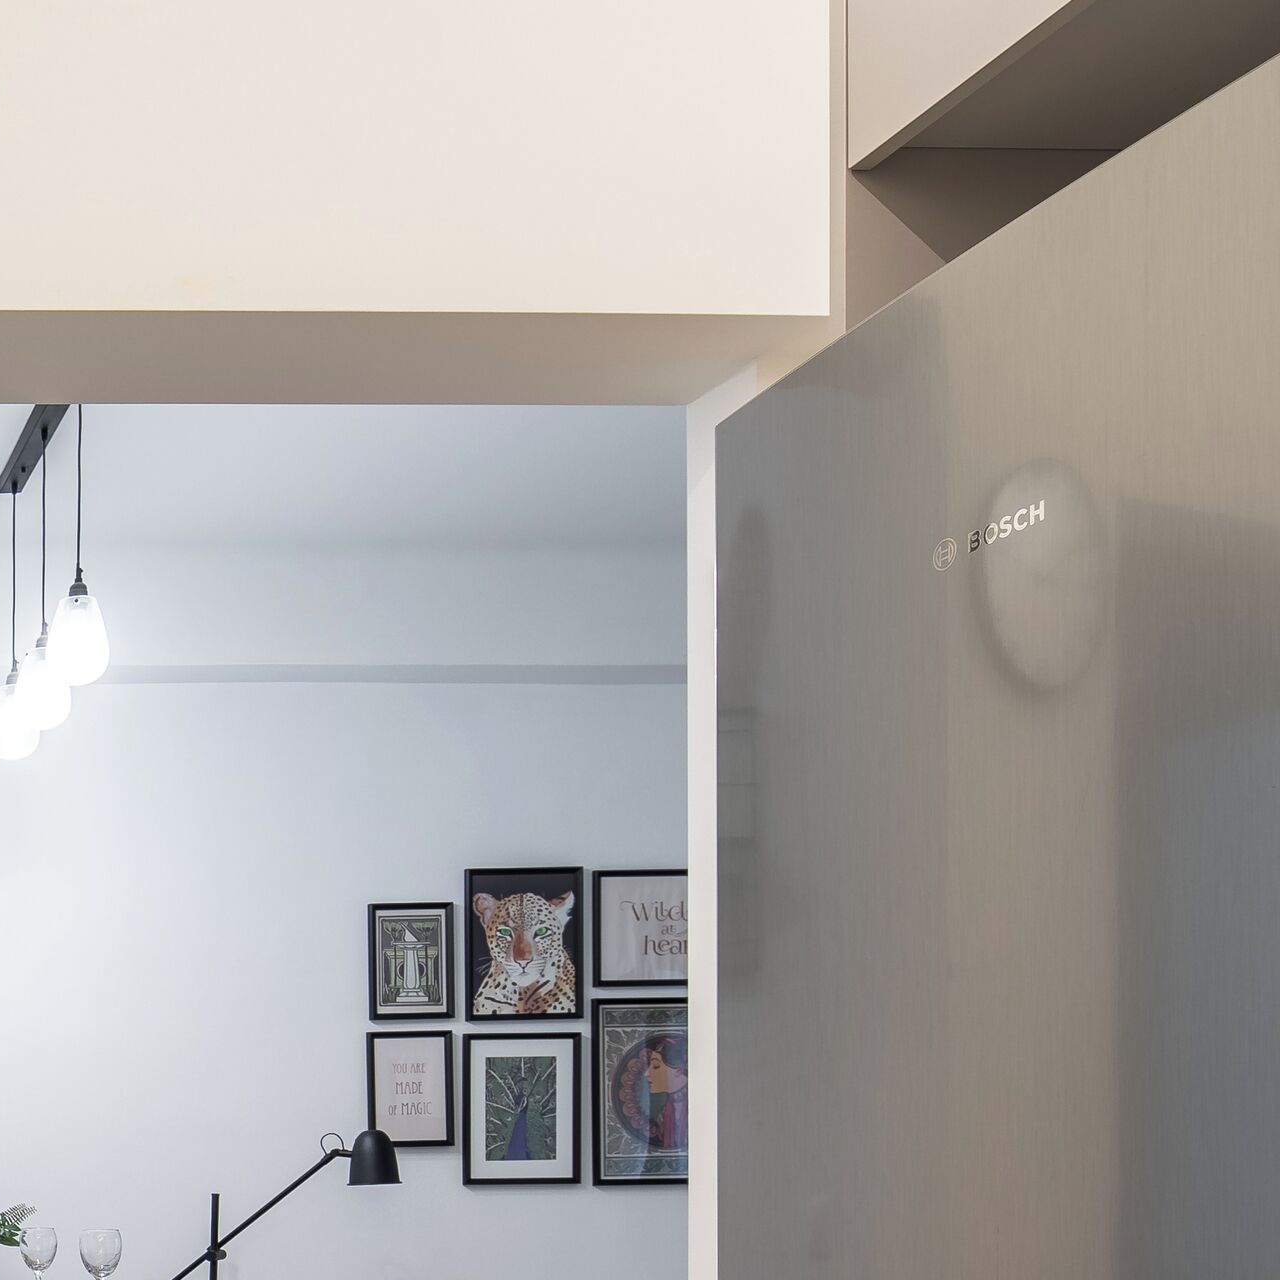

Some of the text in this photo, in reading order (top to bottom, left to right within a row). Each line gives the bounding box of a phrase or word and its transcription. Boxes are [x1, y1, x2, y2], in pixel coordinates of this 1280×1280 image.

[968, 500, 1045, 553] BOSCH
[392, 1063, 426, 1074] YOU ARE
[395, 1081, 423, 1095] MADE
[401, 1102, 432, 1116] MAGIC
